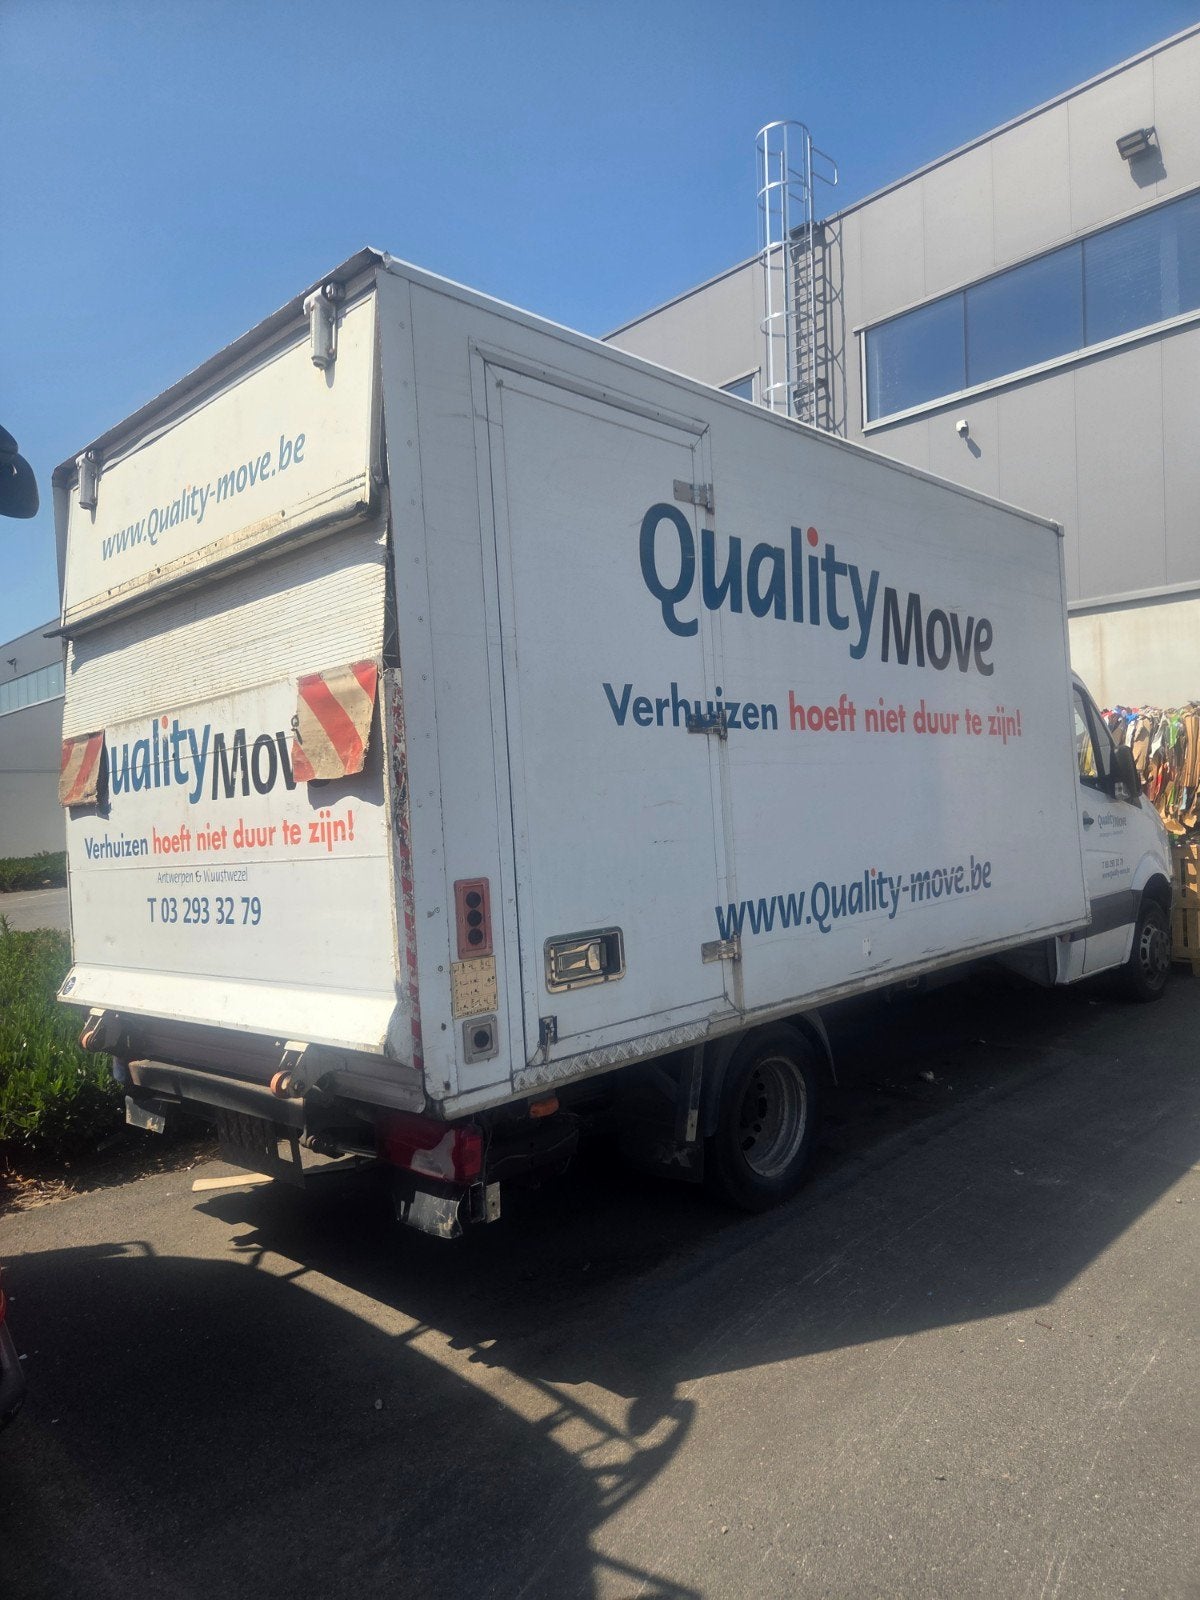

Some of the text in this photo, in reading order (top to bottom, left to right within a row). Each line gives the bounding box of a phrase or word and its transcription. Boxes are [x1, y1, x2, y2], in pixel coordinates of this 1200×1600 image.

[101, 433, 306, 561] www.Quality-move.be
[603, 682, 1022, 745] Verhuizen hoeft niet duur te zijn!
[84, 809, 355, 860] Verhuizen hoeft niet duur te zijn!
[157, 871, 194, 885] Antwerpen
[195, 870, 202, 882] &
[715, 855, 992, 940] www.Quality-move.be
[147, 897, 262, 926] T 03 293 32 79
